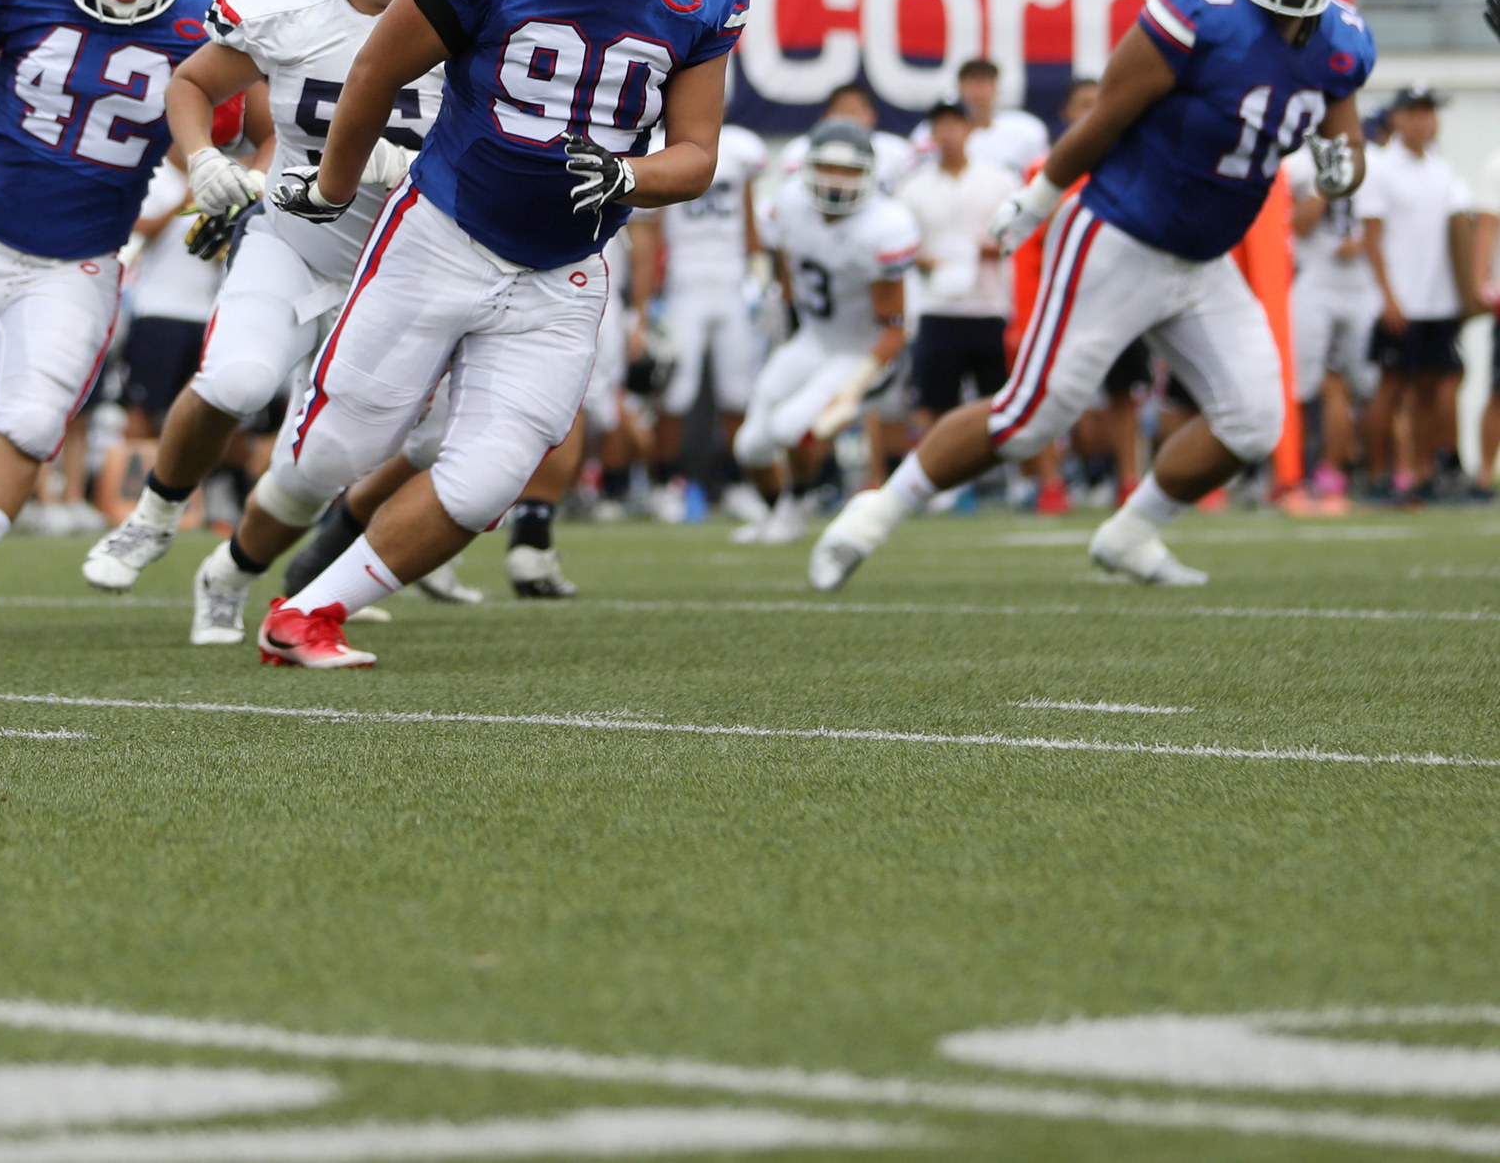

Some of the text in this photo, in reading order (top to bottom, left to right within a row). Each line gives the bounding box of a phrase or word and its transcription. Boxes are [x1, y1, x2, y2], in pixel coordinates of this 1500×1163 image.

[13, 23, 175, 170] 42
[489, 16, 679, 157] 90
[1215, 86, 1328, 179] 10
[568, 270, 588, 288] C
